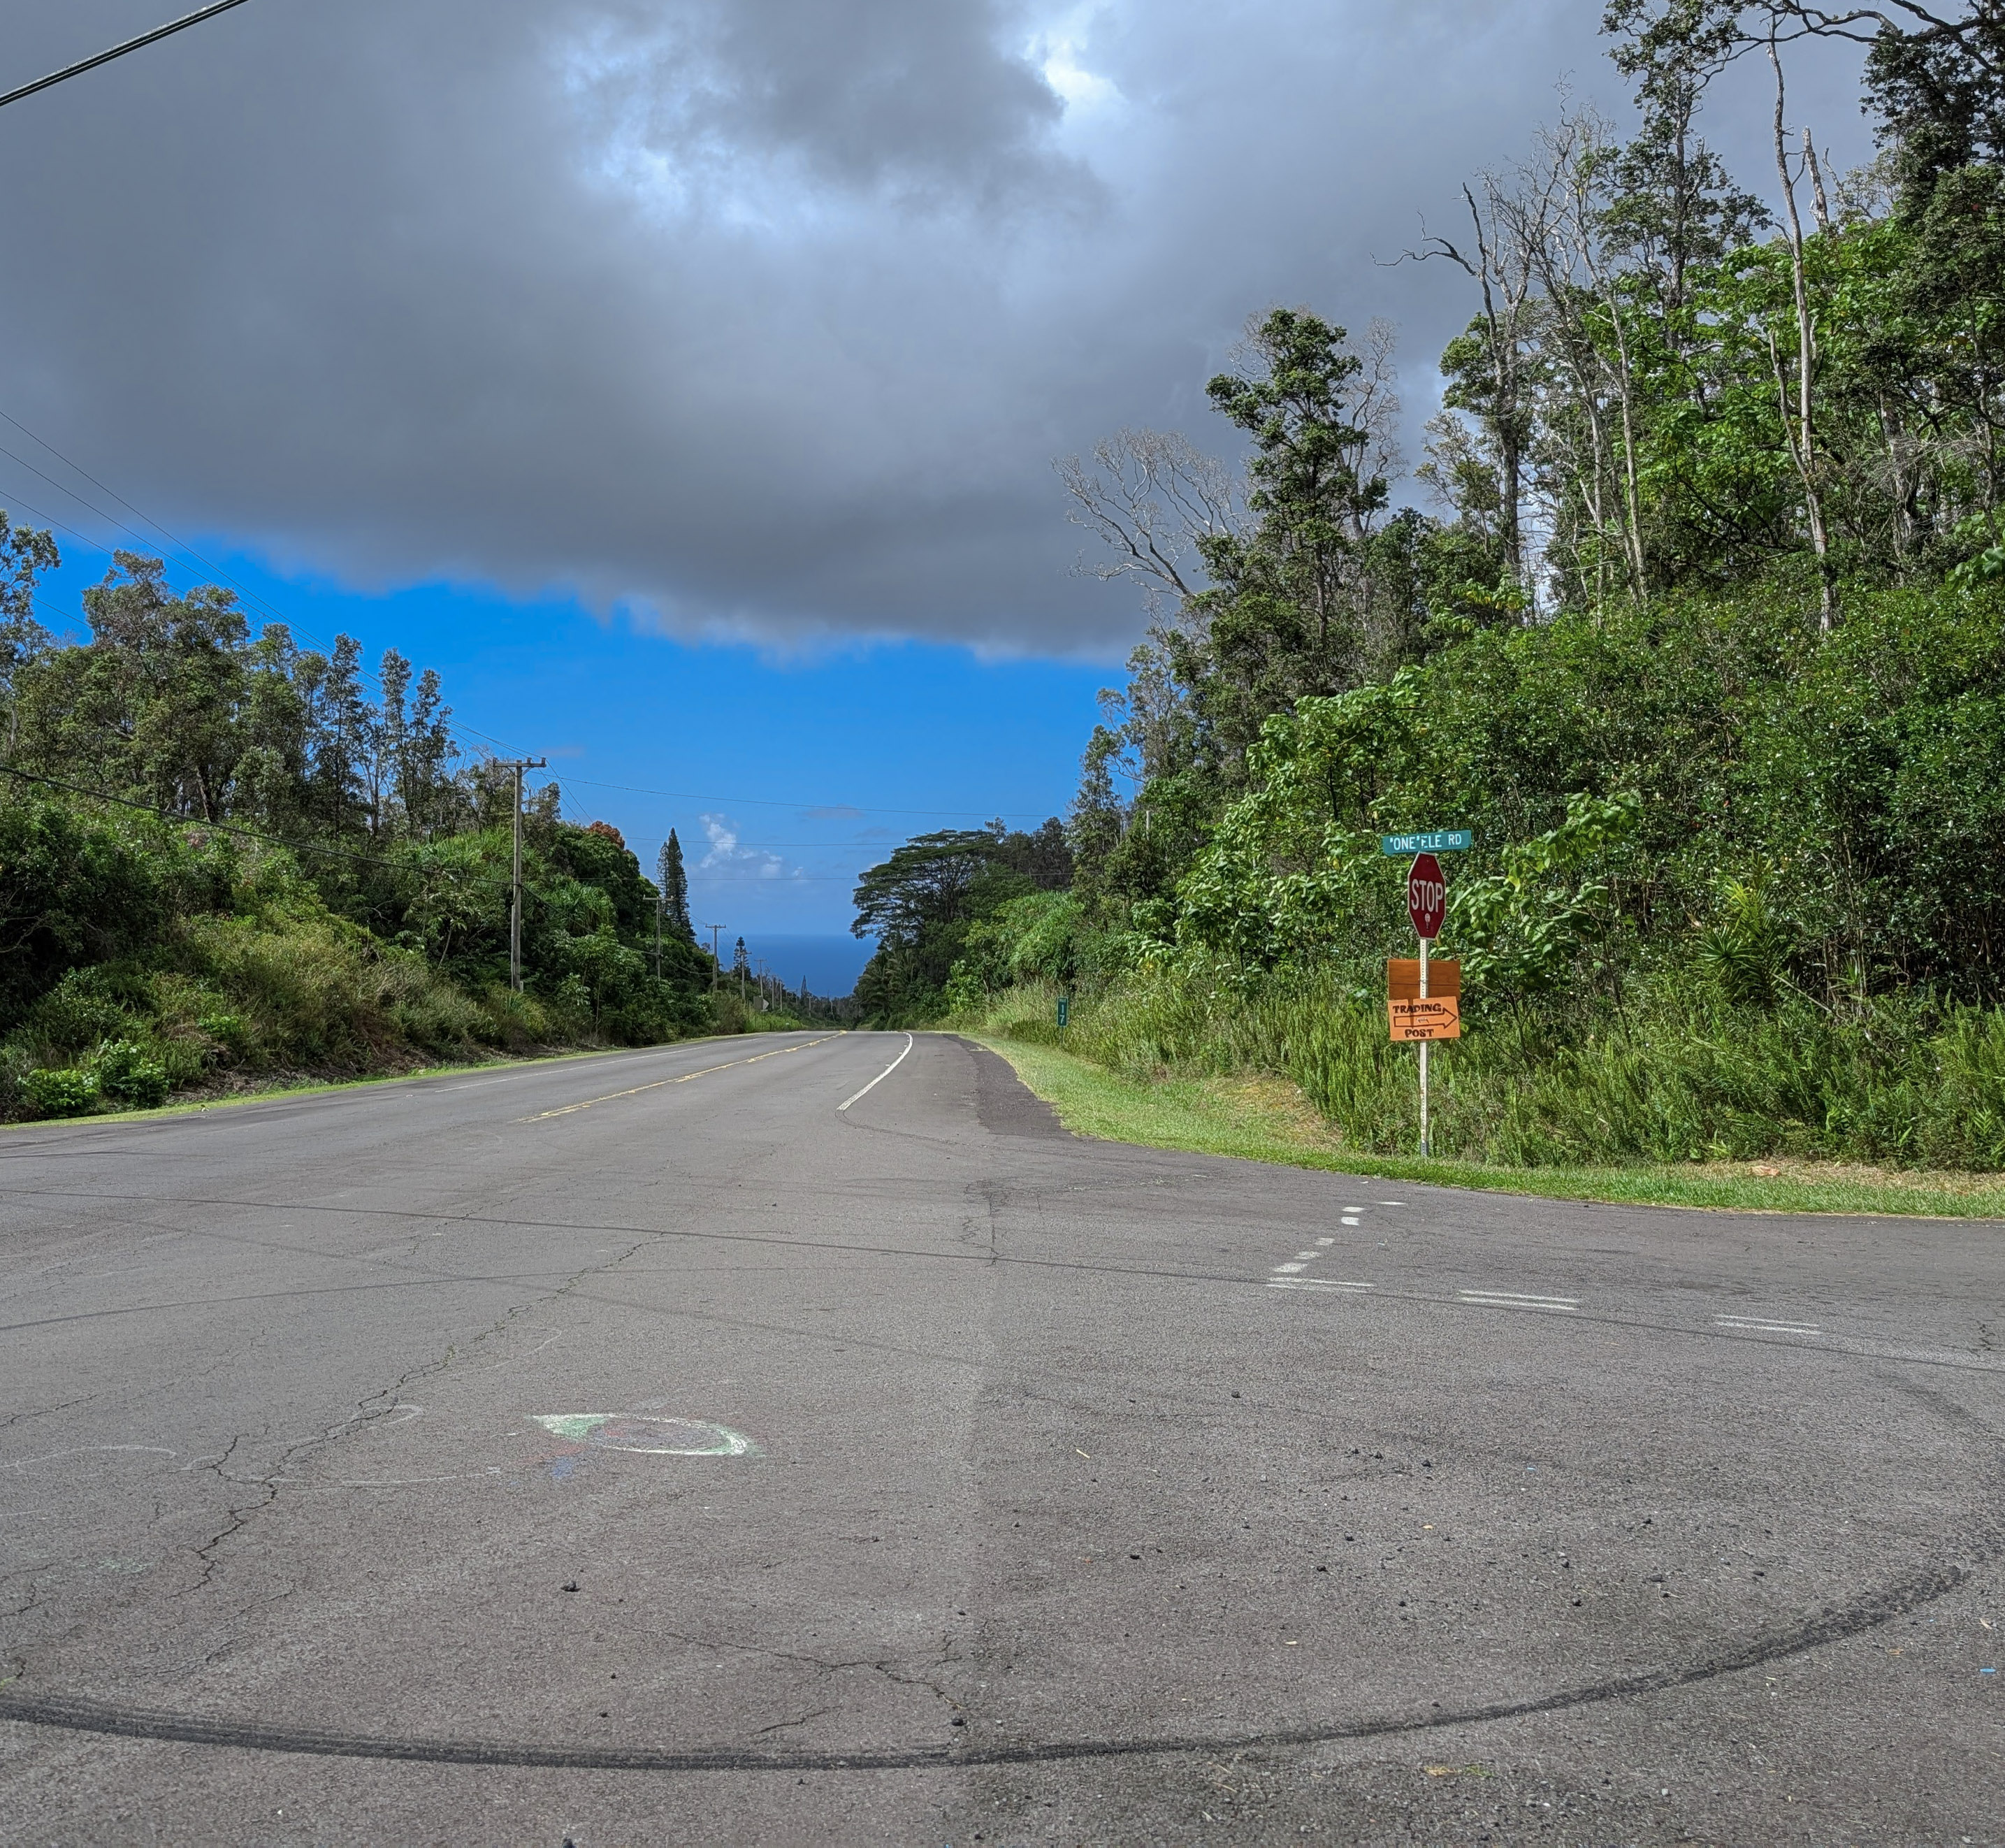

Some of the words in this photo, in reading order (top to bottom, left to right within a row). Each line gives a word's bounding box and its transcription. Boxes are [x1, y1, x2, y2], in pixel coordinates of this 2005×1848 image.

[1448, 833, 1462, 846] RD
[1411, 879, 1443, 913] STOP
[1392, 1003, 1442, 1013] TRADING
[1404, 1029, 1435, 1038] POST
